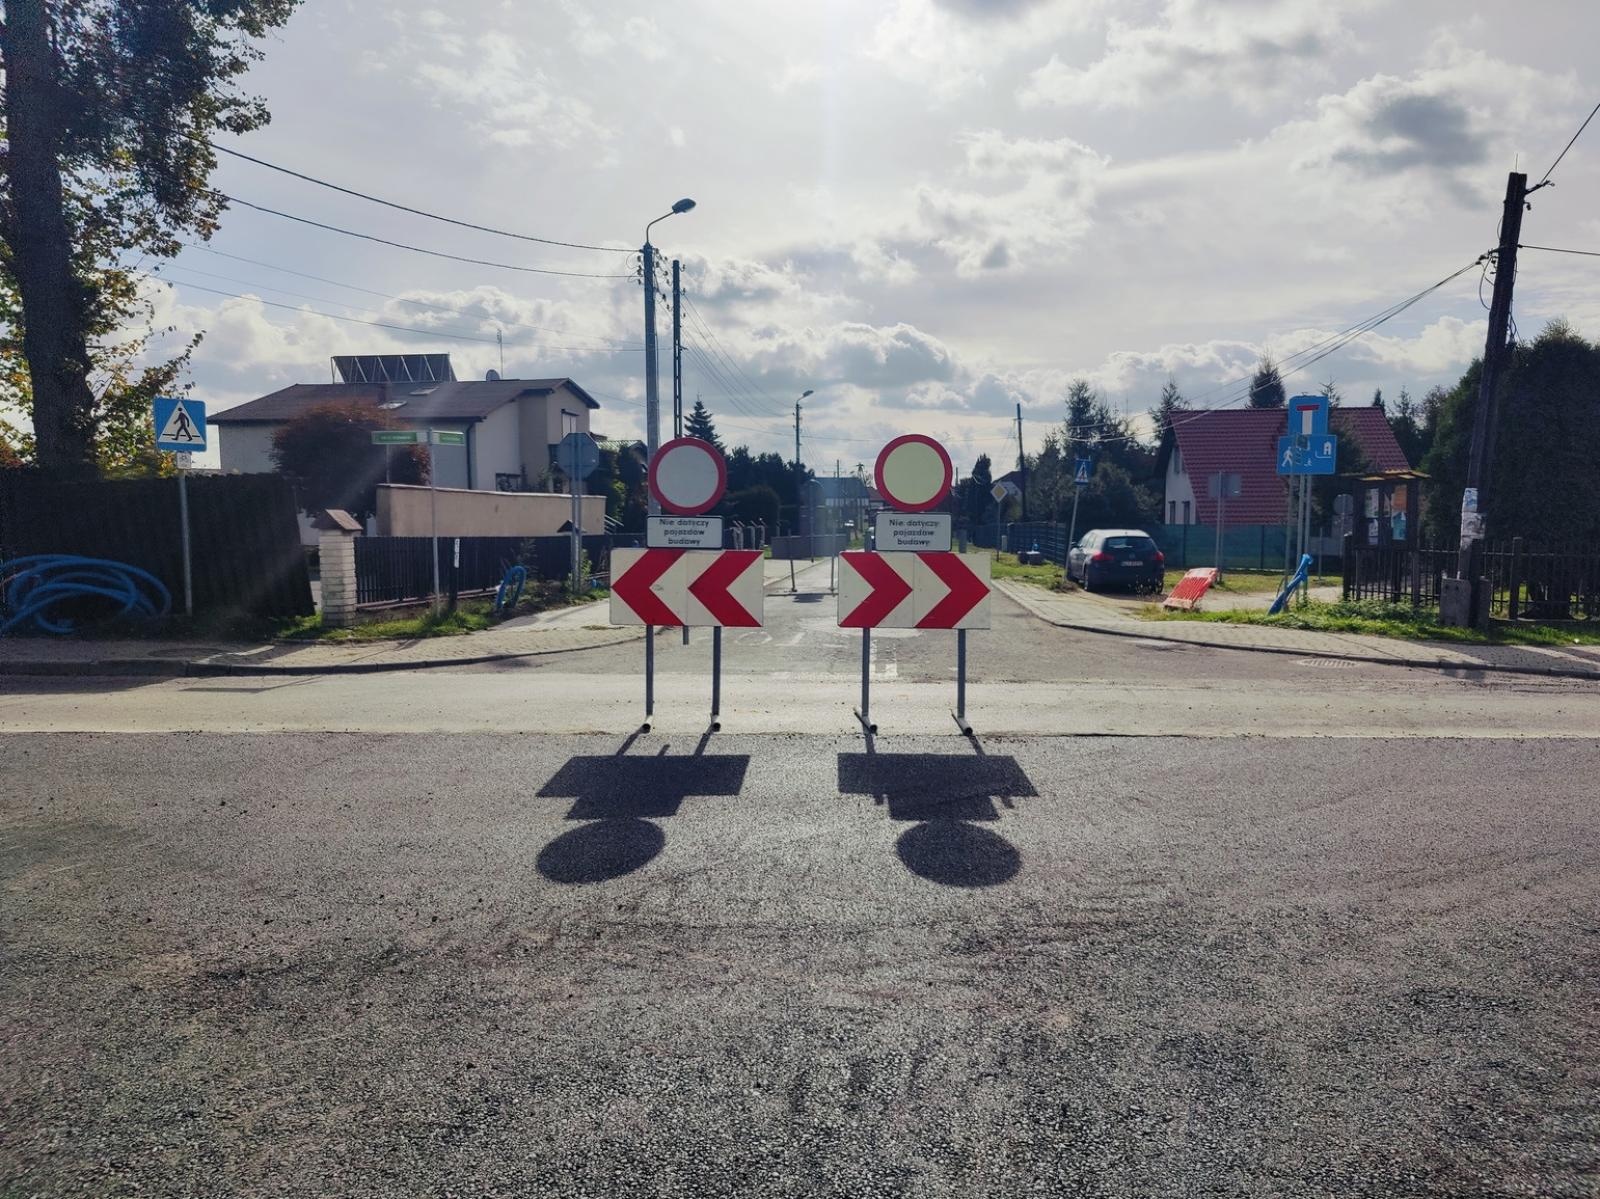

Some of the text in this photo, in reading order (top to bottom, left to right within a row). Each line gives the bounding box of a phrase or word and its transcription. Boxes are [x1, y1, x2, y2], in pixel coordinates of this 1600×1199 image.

[659, 518, 709, 528] Nie dotyczy
[889, 519, 940, 528] Nie dotyczy
[668, 538, 701, 546] budowy
[897, 538, 930, 547] budowy
